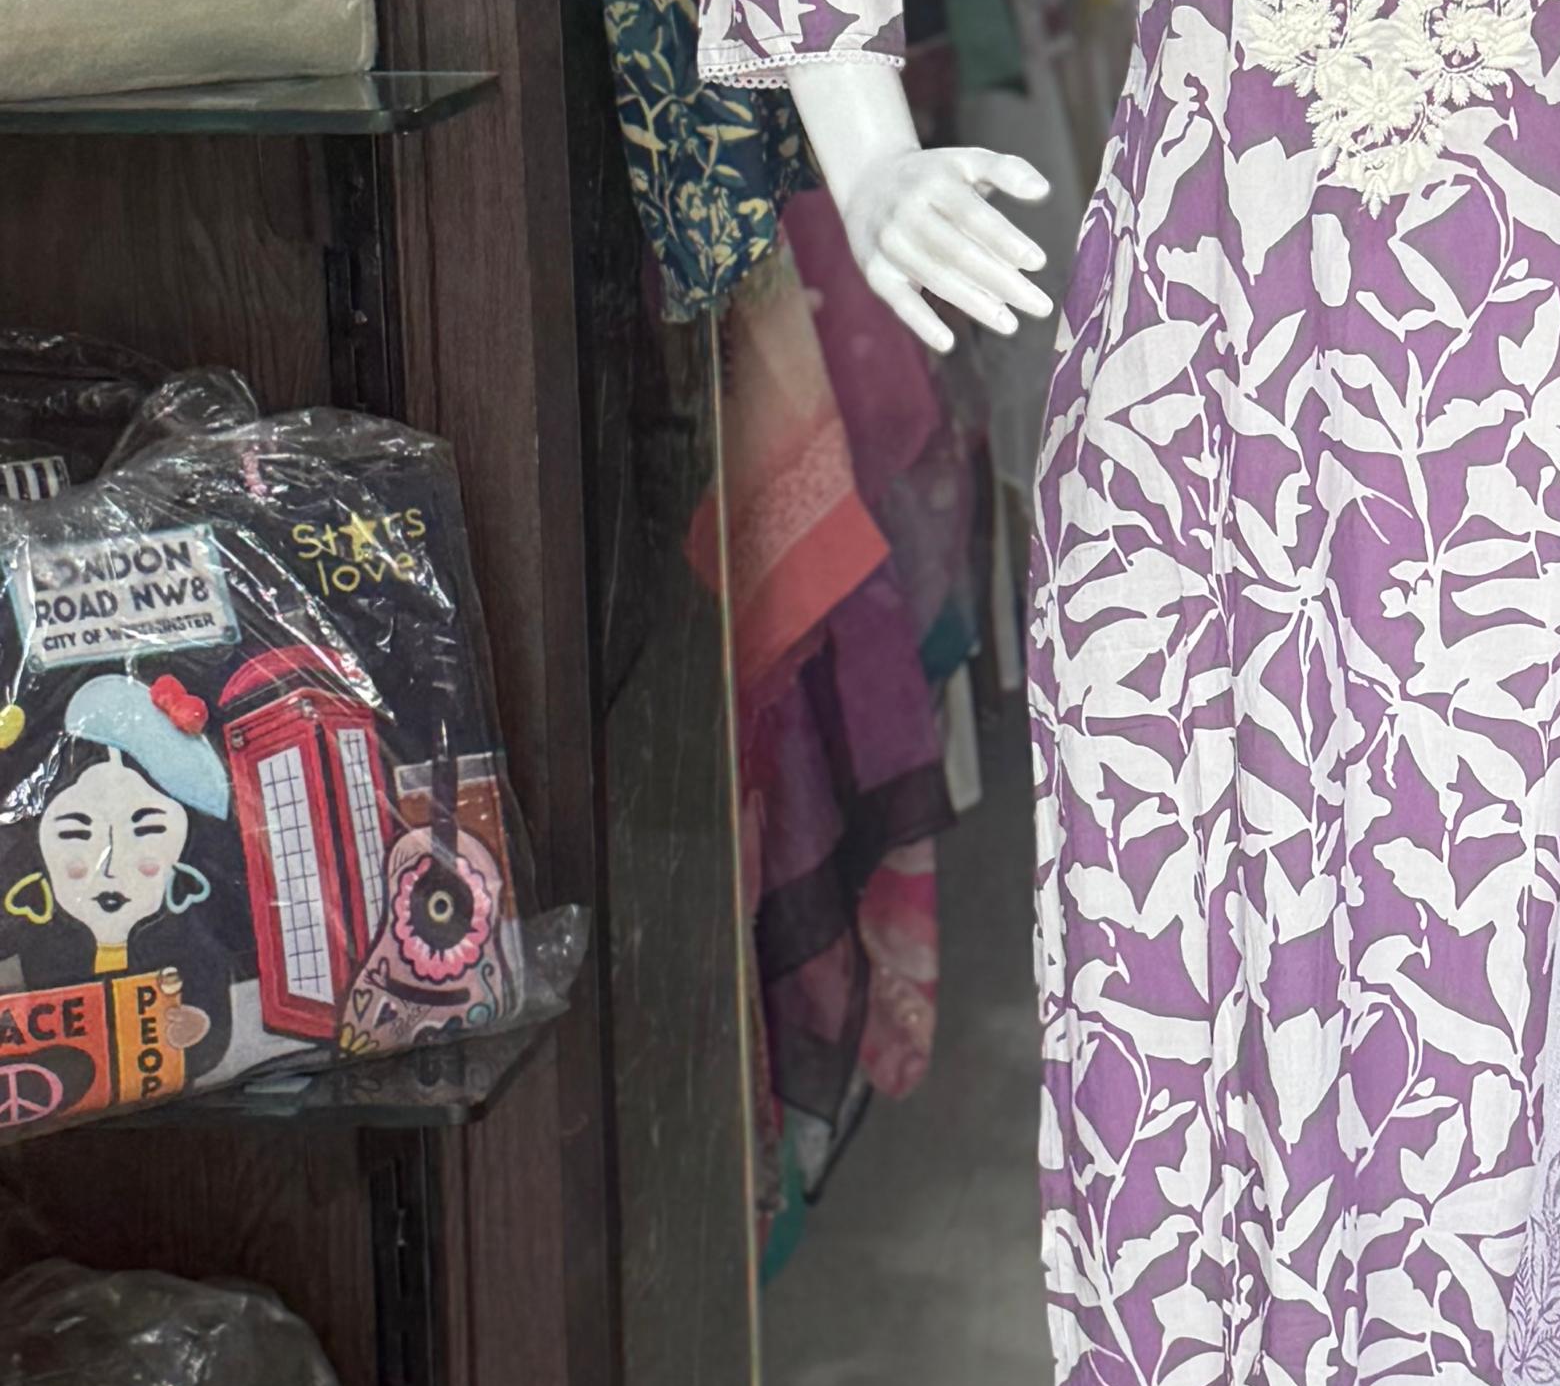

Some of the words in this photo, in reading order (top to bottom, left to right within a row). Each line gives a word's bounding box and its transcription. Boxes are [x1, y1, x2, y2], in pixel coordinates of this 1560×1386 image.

[317, 552, 416, 597] love
[35, 589, 119, 628] ROAD
[129, 575, 210, 612] NW8
[43, 628, 76, 651] CITY
[82, 625, 101, 645] OF
